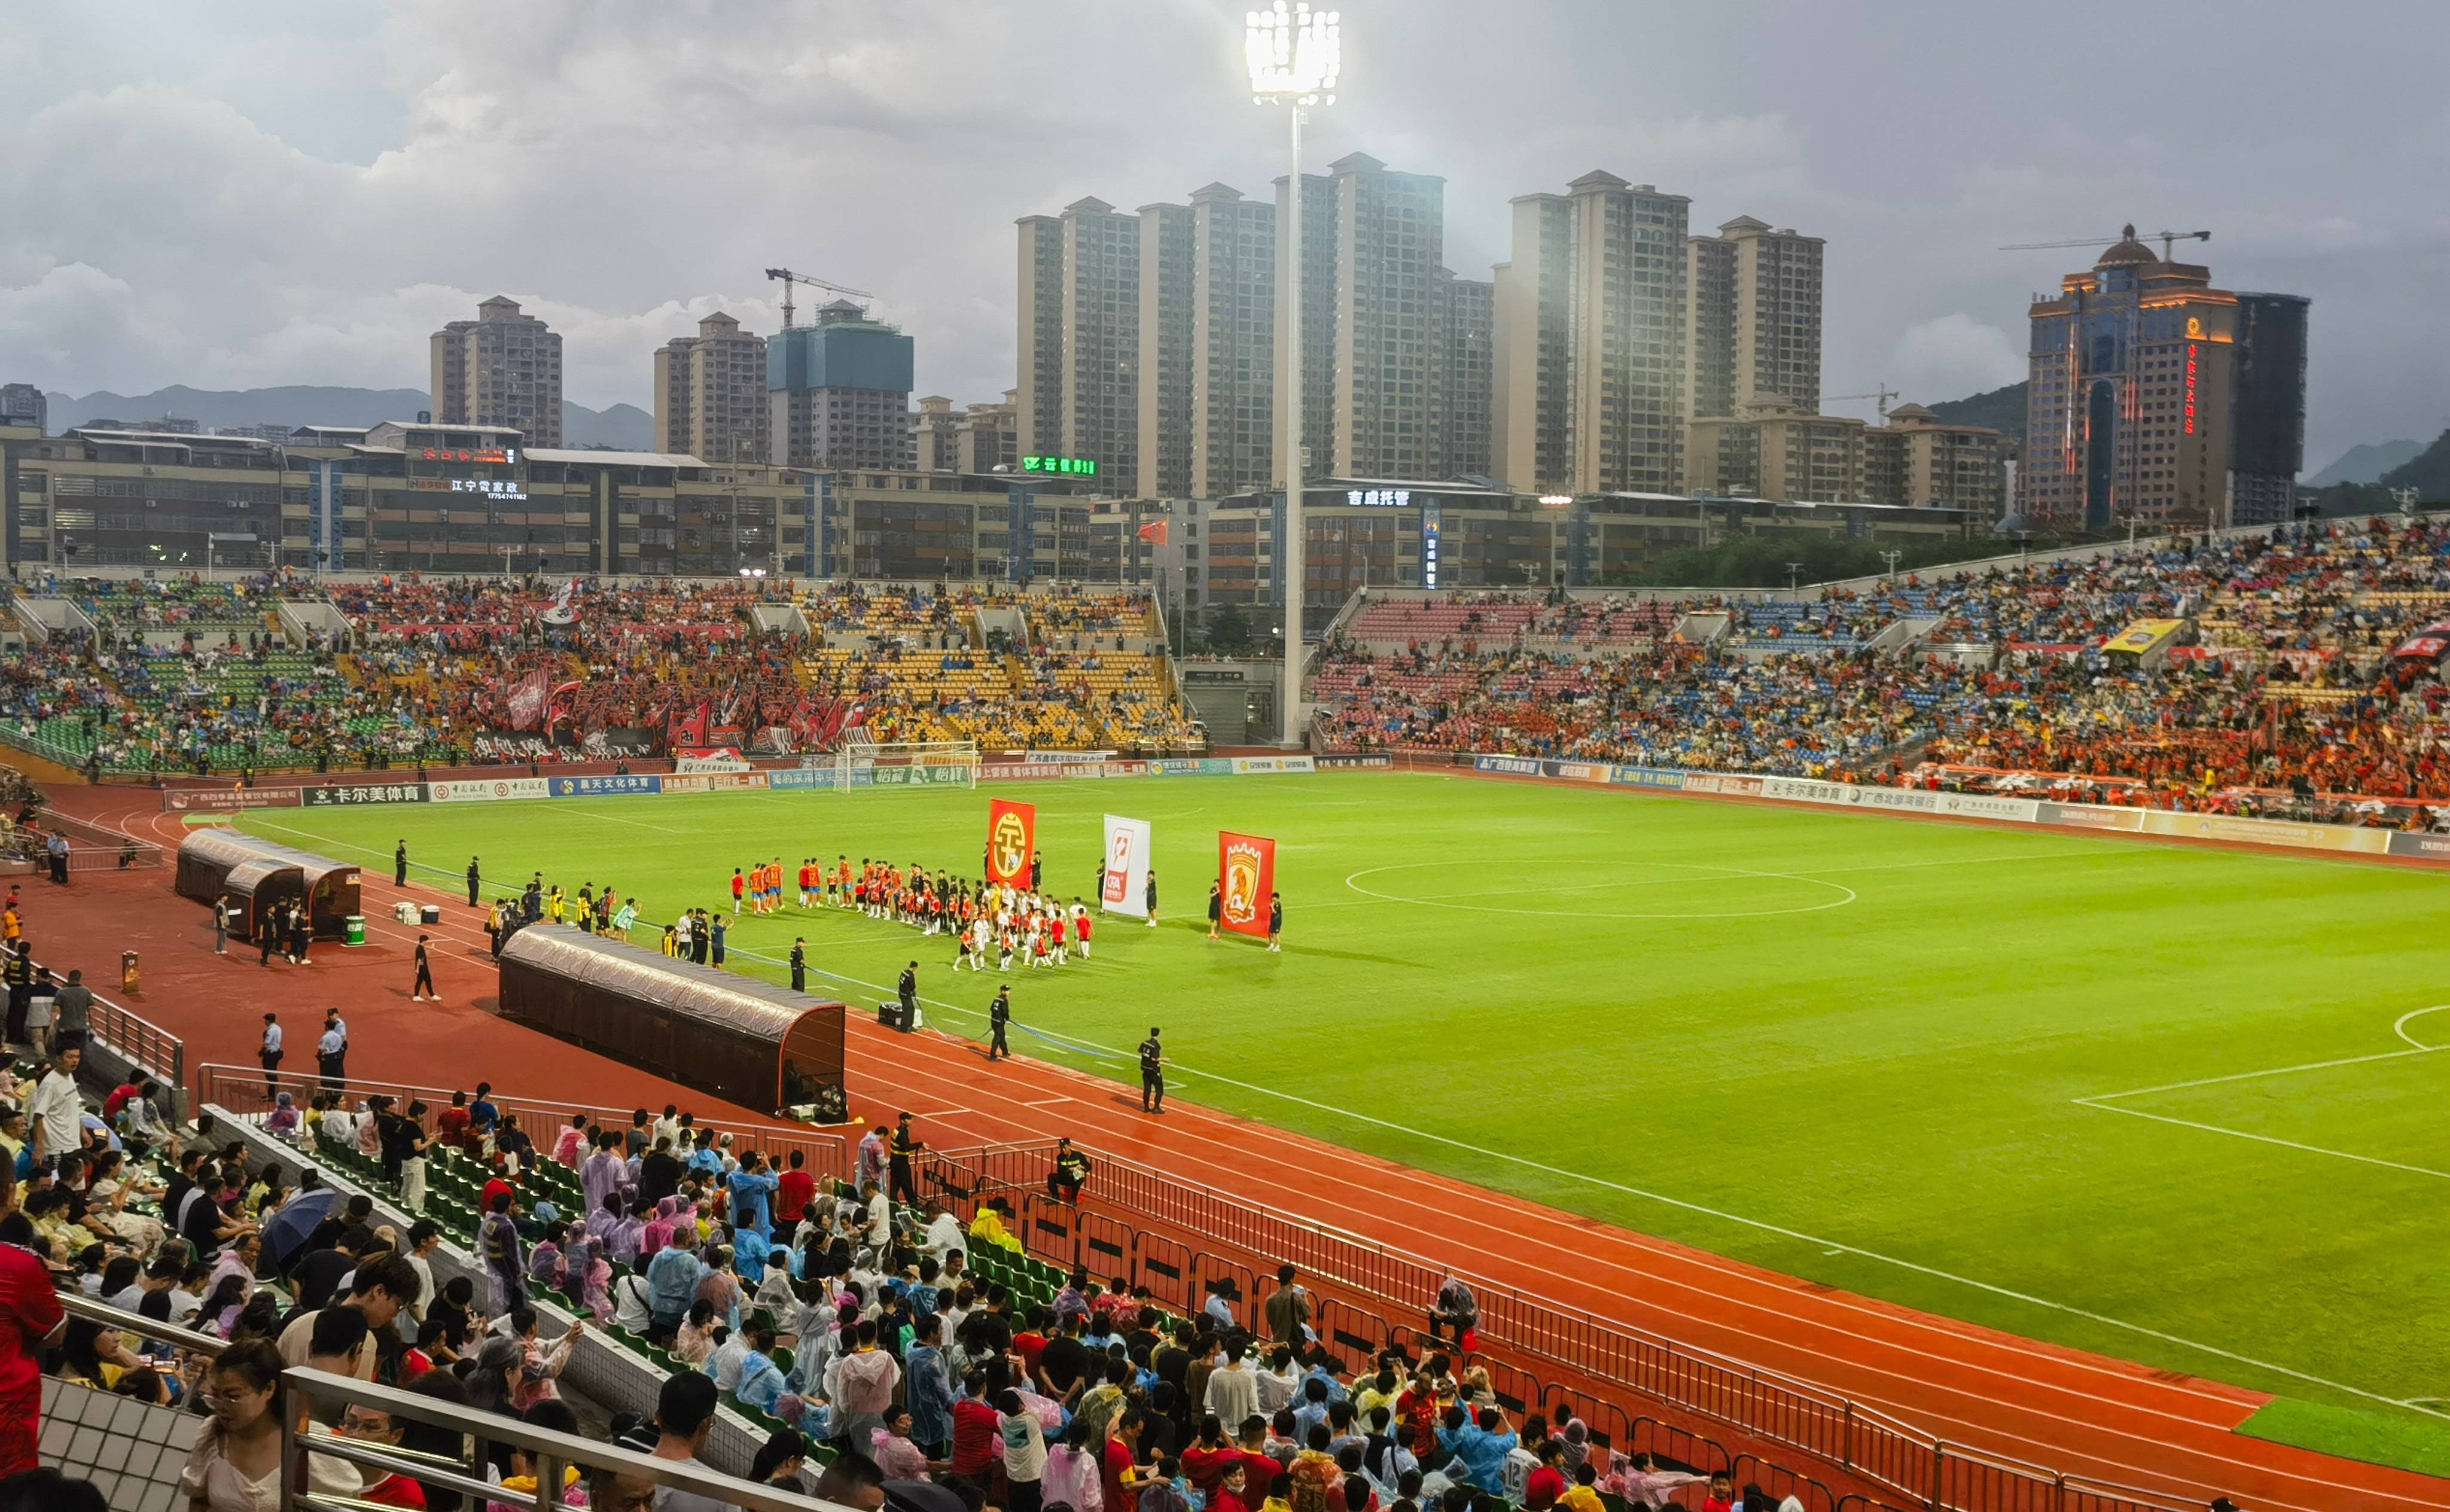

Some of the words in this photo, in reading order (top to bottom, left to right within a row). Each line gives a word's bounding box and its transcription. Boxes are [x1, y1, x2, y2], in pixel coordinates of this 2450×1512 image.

[334, 786, 419, 803] 卡尔美体育
[1785, 784, 1841, 800] 卡尔美体育
[1508, 1462, 1520, 1488] 12
